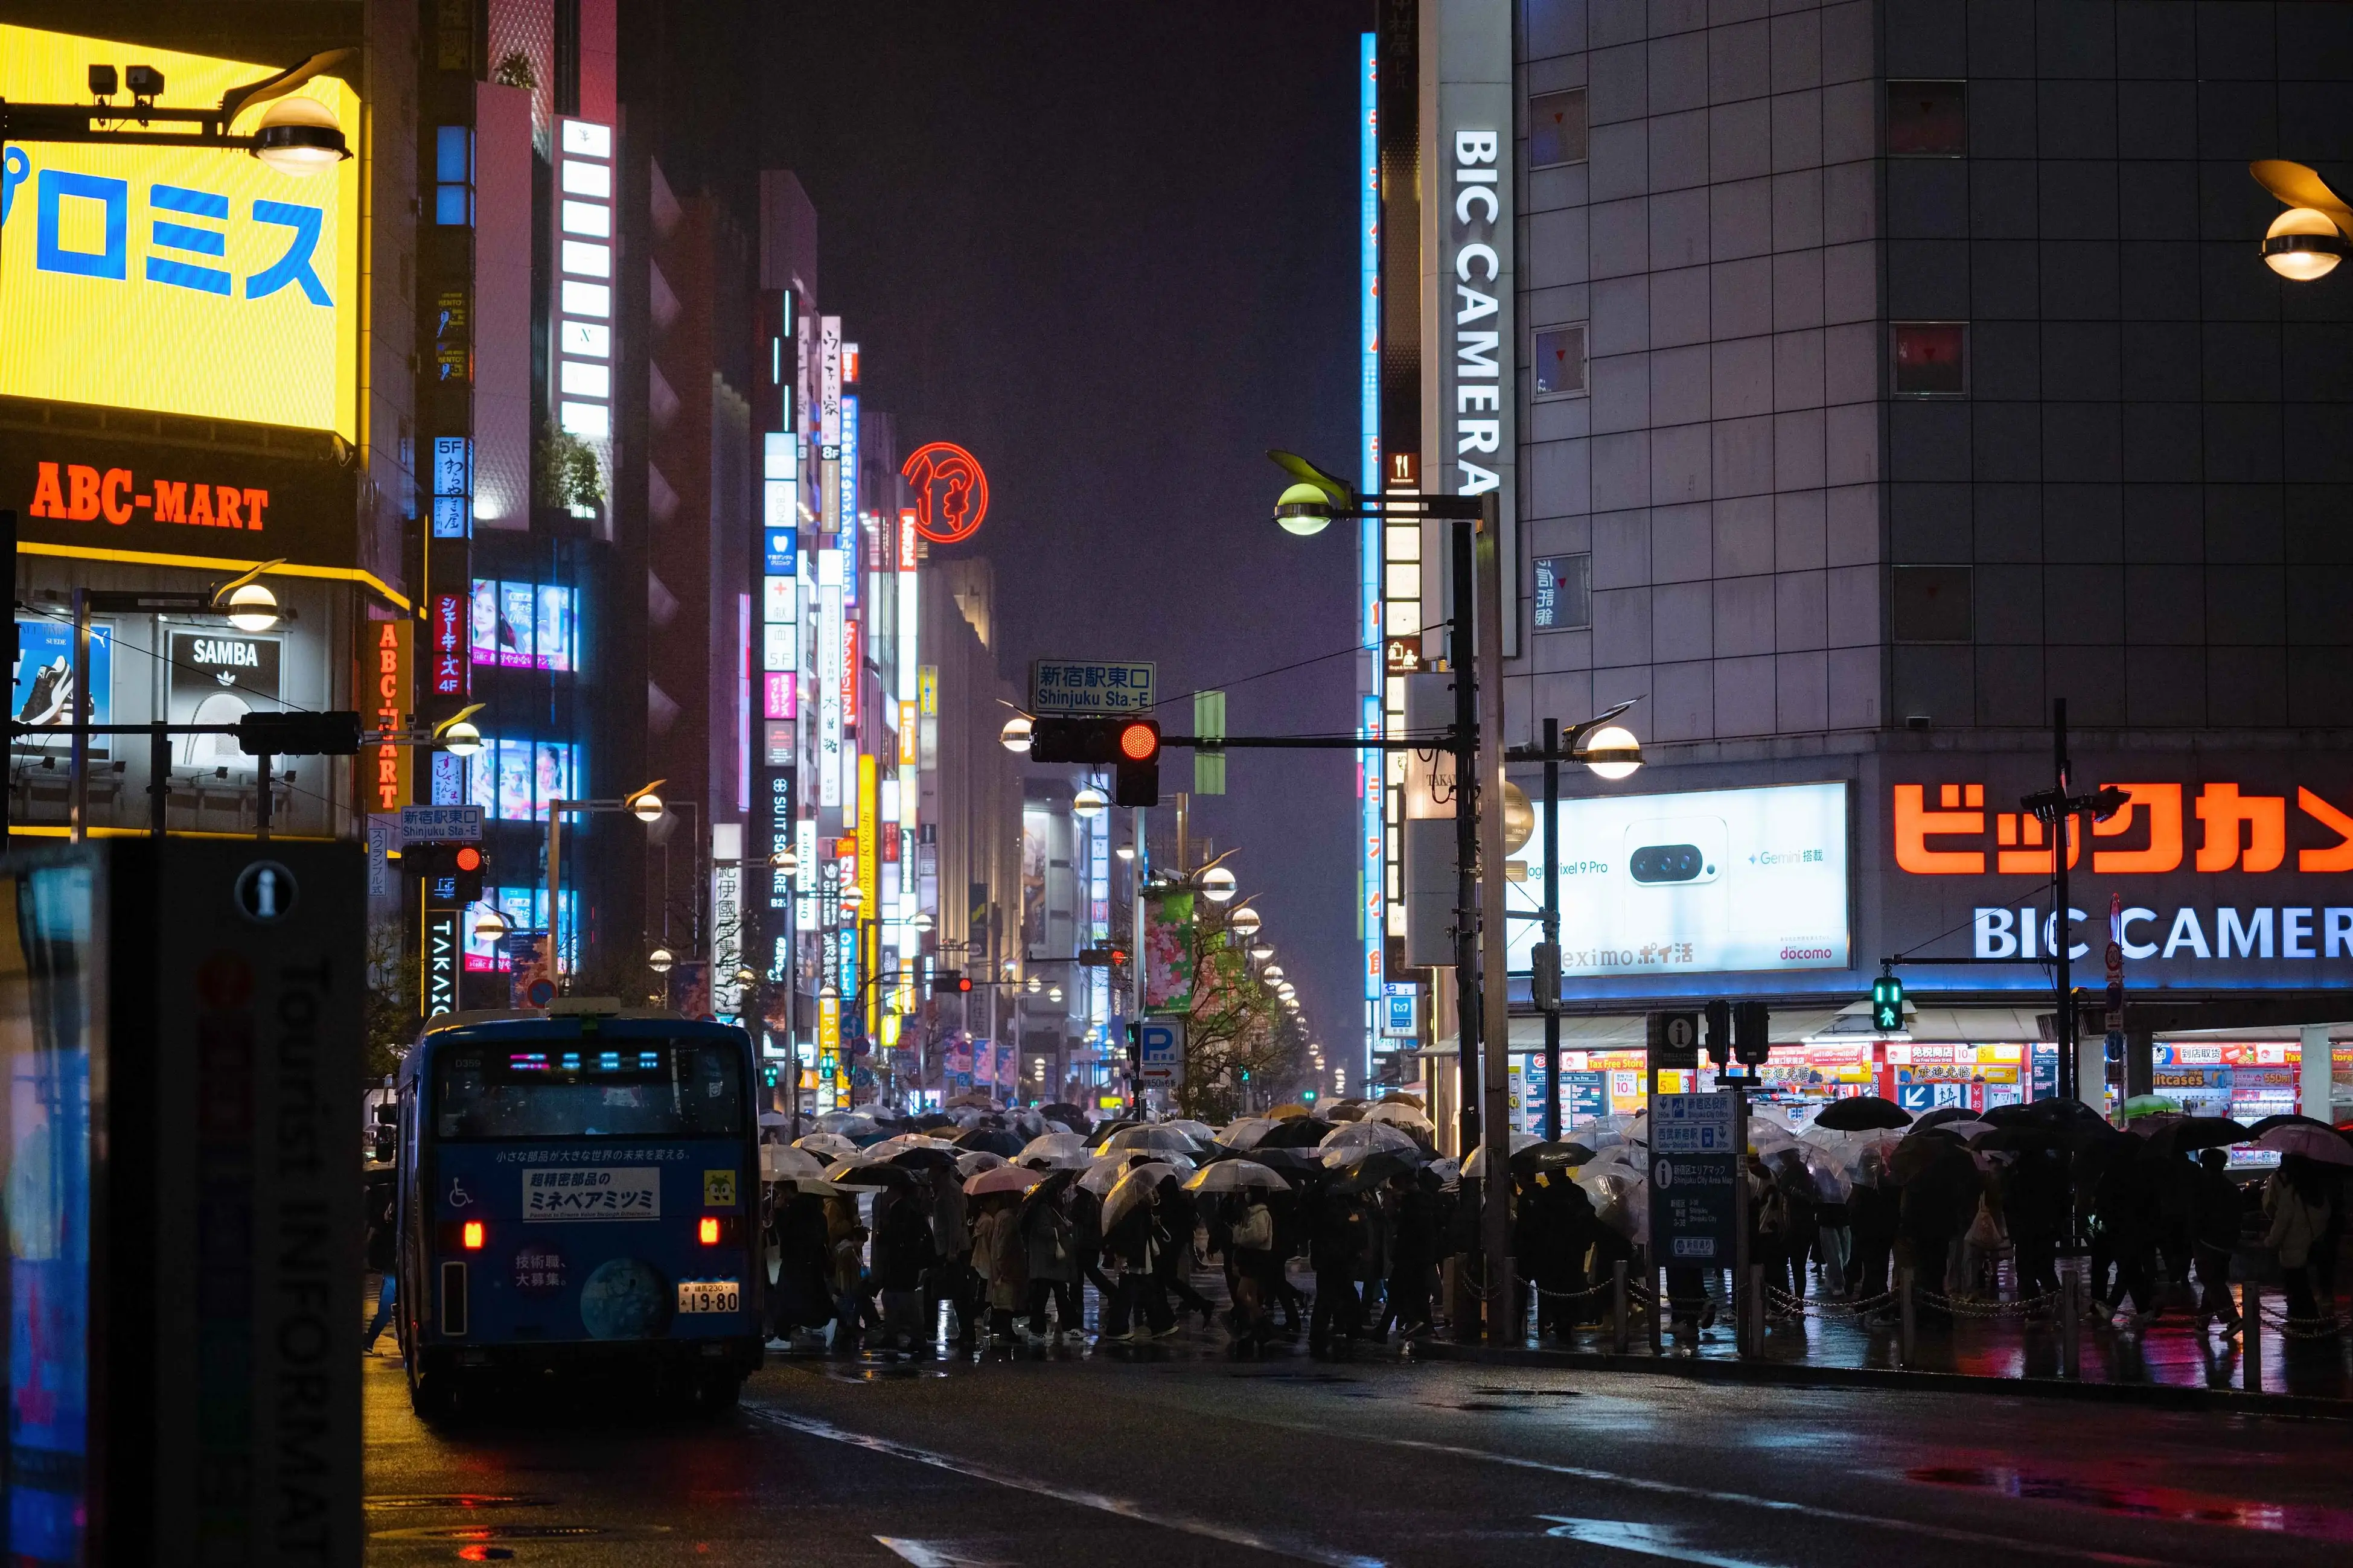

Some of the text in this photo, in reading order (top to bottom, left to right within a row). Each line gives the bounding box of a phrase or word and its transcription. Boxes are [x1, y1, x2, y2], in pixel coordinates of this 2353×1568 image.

[1455, 131, 1499, 495] BIC CAMERA
[439, 441, 461, 453] 5F
[822, 446, 839, 459] 8F
[30, 462, 268, 531] ABC-MART
[441, 597, 459, 675] シェーキーズ
[193, 639, 258, 667] SAMBA
[770, 652, 791, 666] 5F
[1040, 664, 1149, 689] 新宿駅東口
[439, 680, 458, 692] 4F
[1038, 689, 1100, 707] Shinjuku
[403, 810, 477, 824] 新宿駅東口
[403, 826, 445, 838] Shinjuku
[774, 796, 787, 894] SUIT SQRE
[371, 831, 383, 894] スクランブル式
[1760, 849, 1824, 864] Gemini 搭載
[1580, 861, 1587, 874] 9
[1589, 861, 1608, 873] Pro
[1974, 907, 2090, 959] BIC
[1563, 942, 1693, 968] eximo ポイ活
[1780, 946, 1832, 960] docomo
[1143, 1028, 1173, 1061] P
[1912, 1047, 1953, 1058] 免税商店
[2182, 1048, 2221, 1058] 到店取货
[2285, 1053, 2353, 1062] Tax tore
[1588, 1060, 1603, 1068] Tax
[1622, 1059, 1644, 1068] Store
[1918, 1066, 1971, 1079] 欢迎光临
[1616, 1082, 1629, 1093] 10
[1659, 1080, 1667, 1091] 5
[1688, 1097, 1728, 1110] 新宿区役所
[1658, 1128, 1699, 1141] 西武新宿駅
[496, 1149, 690, 1163] 小さな部品が大きな世界の未来を変える。
[1673, 1165, 1726, 1176] 新宿区エリアマップ
[530, 1172, 610, 1188] 超精密部品の
[1673, 1177, 1697, 1185] Shinjuku
[1697, 1178, 1708, 1186] City
[529, 1191, 653, 1211] ミネベアミツミ
[515, 1255, 566, 1269] 技術職、
[515, 1273, 566, 1287] 大募集。
[689, 1292, 738, 1312] 19-80
